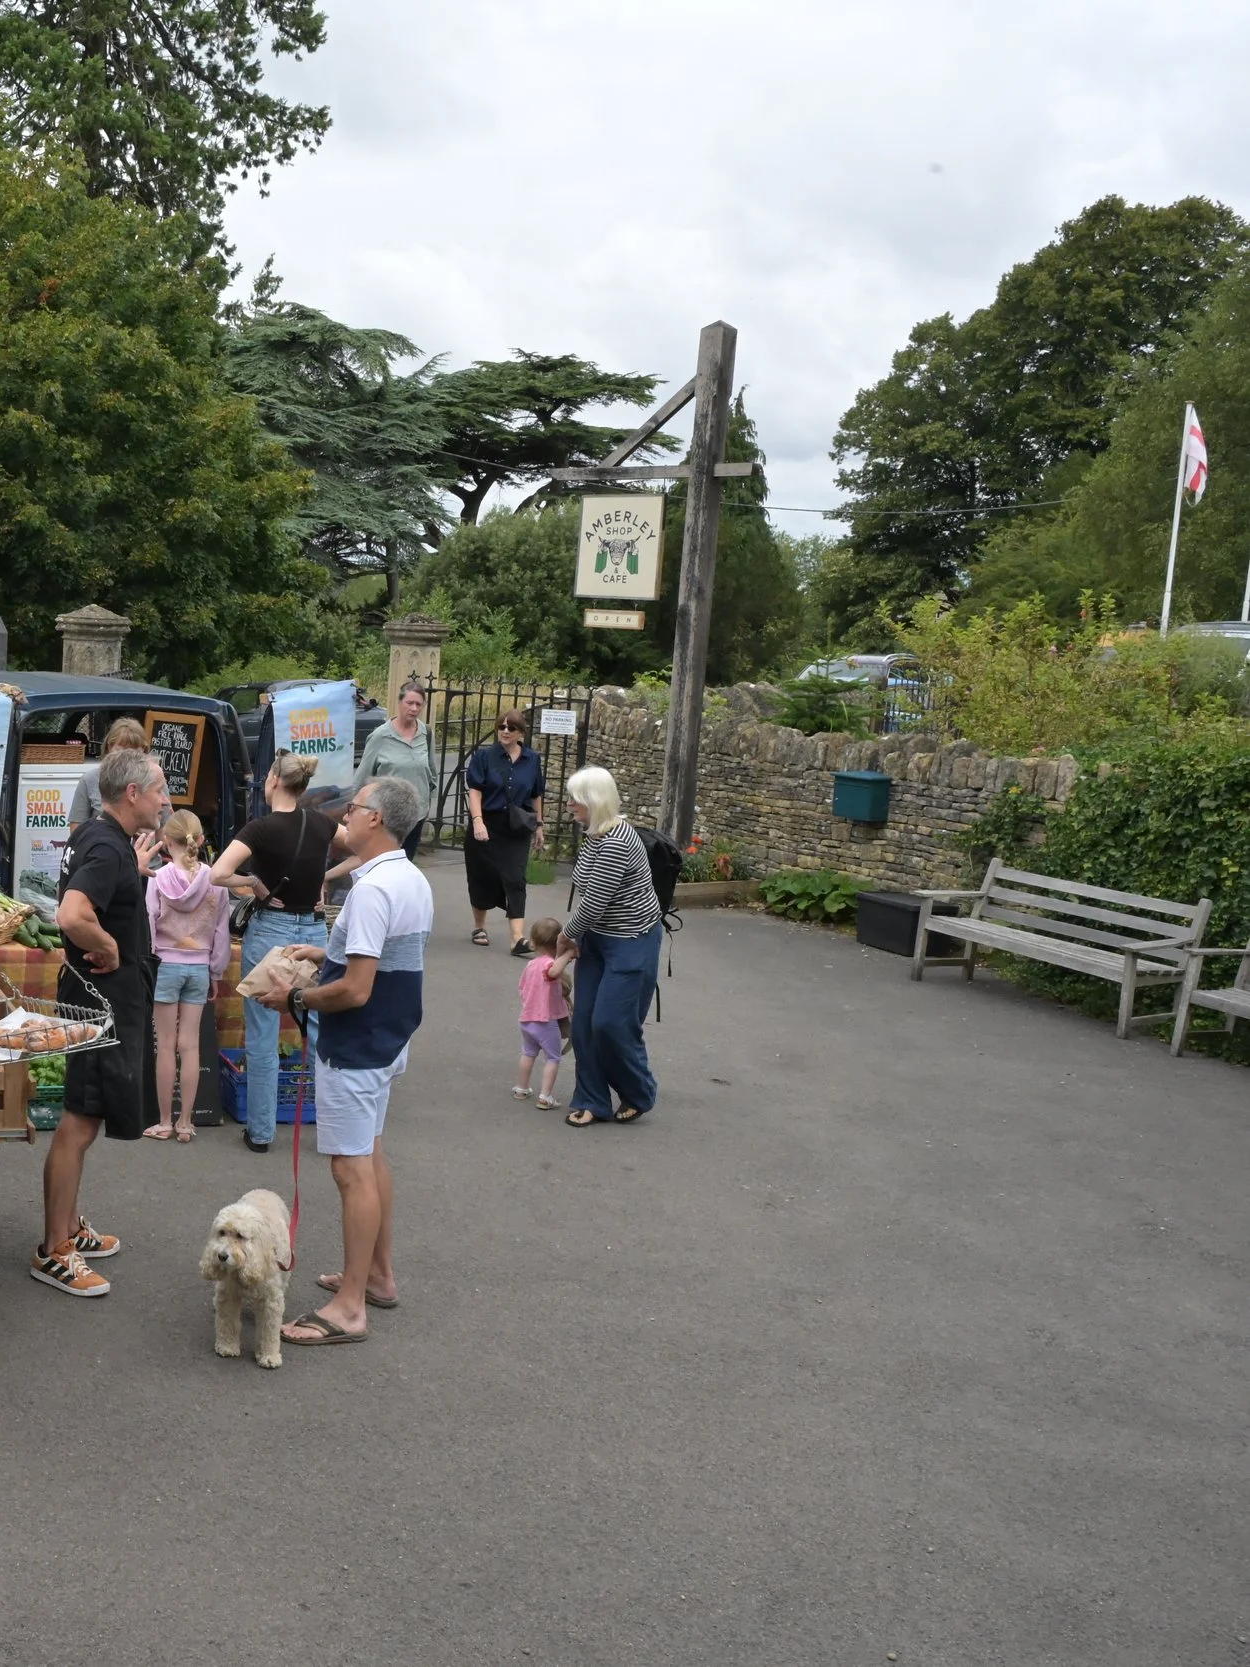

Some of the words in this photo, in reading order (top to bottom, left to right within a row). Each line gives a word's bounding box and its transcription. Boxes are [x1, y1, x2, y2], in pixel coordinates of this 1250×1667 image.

[585, 510, 656, 542] AMBERLEY
[606, 527, 632, 536] SHOP
[593, 615, 632, 623] OPEN
[288, 707, 330, 725] GOOD
[161, 723, 185, 734] ORGANIC
[290, 721, 337, 740] SMALL
[151, 737, 172, 748] PASTURE
[174, 740, 193, 751] REARED
[291, 737, 337, 755] FARMS
[26, 789, 61, 802] GOOD
[26, 802, 66, 815] SMALL
[26, 815, 66, 828] FARMS
